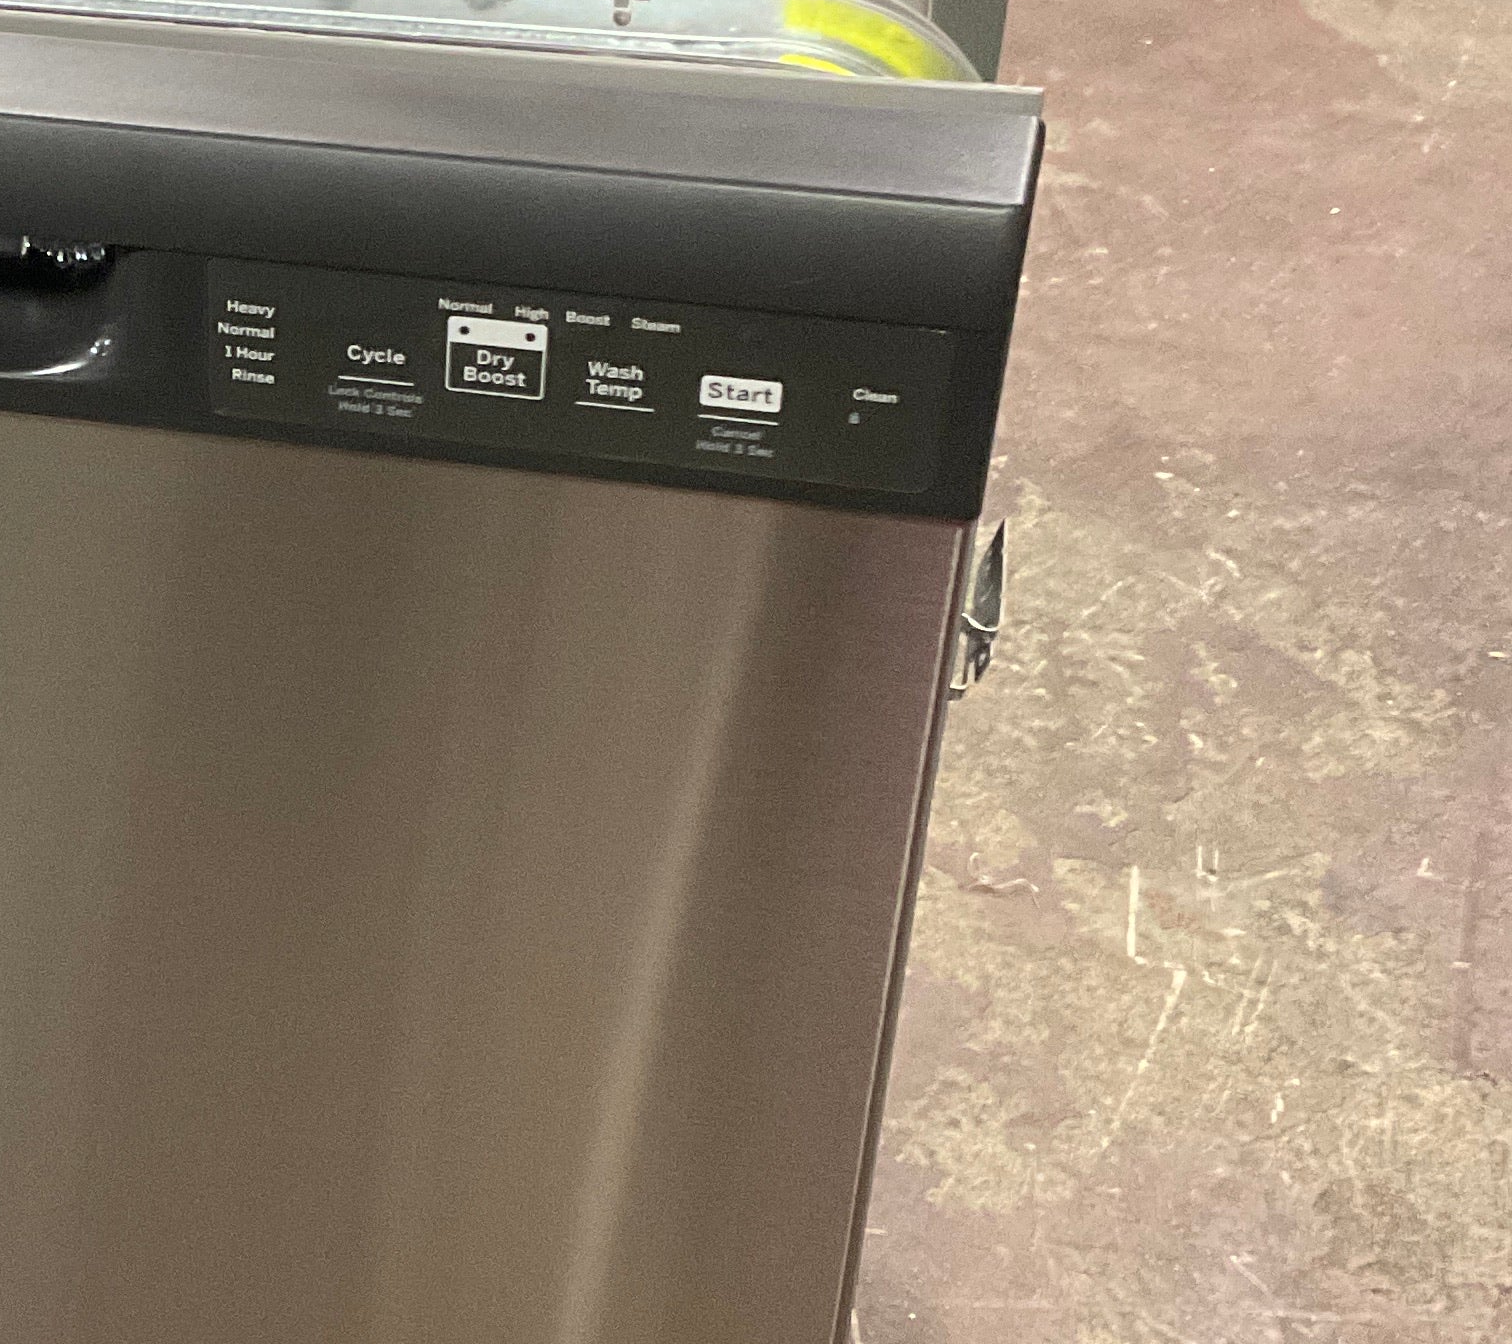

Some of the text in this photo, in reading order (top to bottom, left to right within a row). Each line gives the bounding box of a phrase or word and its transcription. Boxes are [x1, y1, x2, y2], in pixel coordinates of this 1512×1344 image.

[227, 299, 276, 319] Heavy
[438, 297, 549, 322] Normal High
[565, 309, 611, 327] Boost
[217, 321, 276, 339] Normal
[630, 316, 682, 334] Steam
[224, 345, 276, 362] 1 Hour
[346, 343, 407, 365] Cycle
[475, 348, 515, 371] Dry
[231, 367, 276, 385] Rinse
[462, 365, 528, 388] Boost
[587, 360, 645, 382] Wash
[585, 378, 644, 403] Temp
[707, 381, 774, 406] Start
